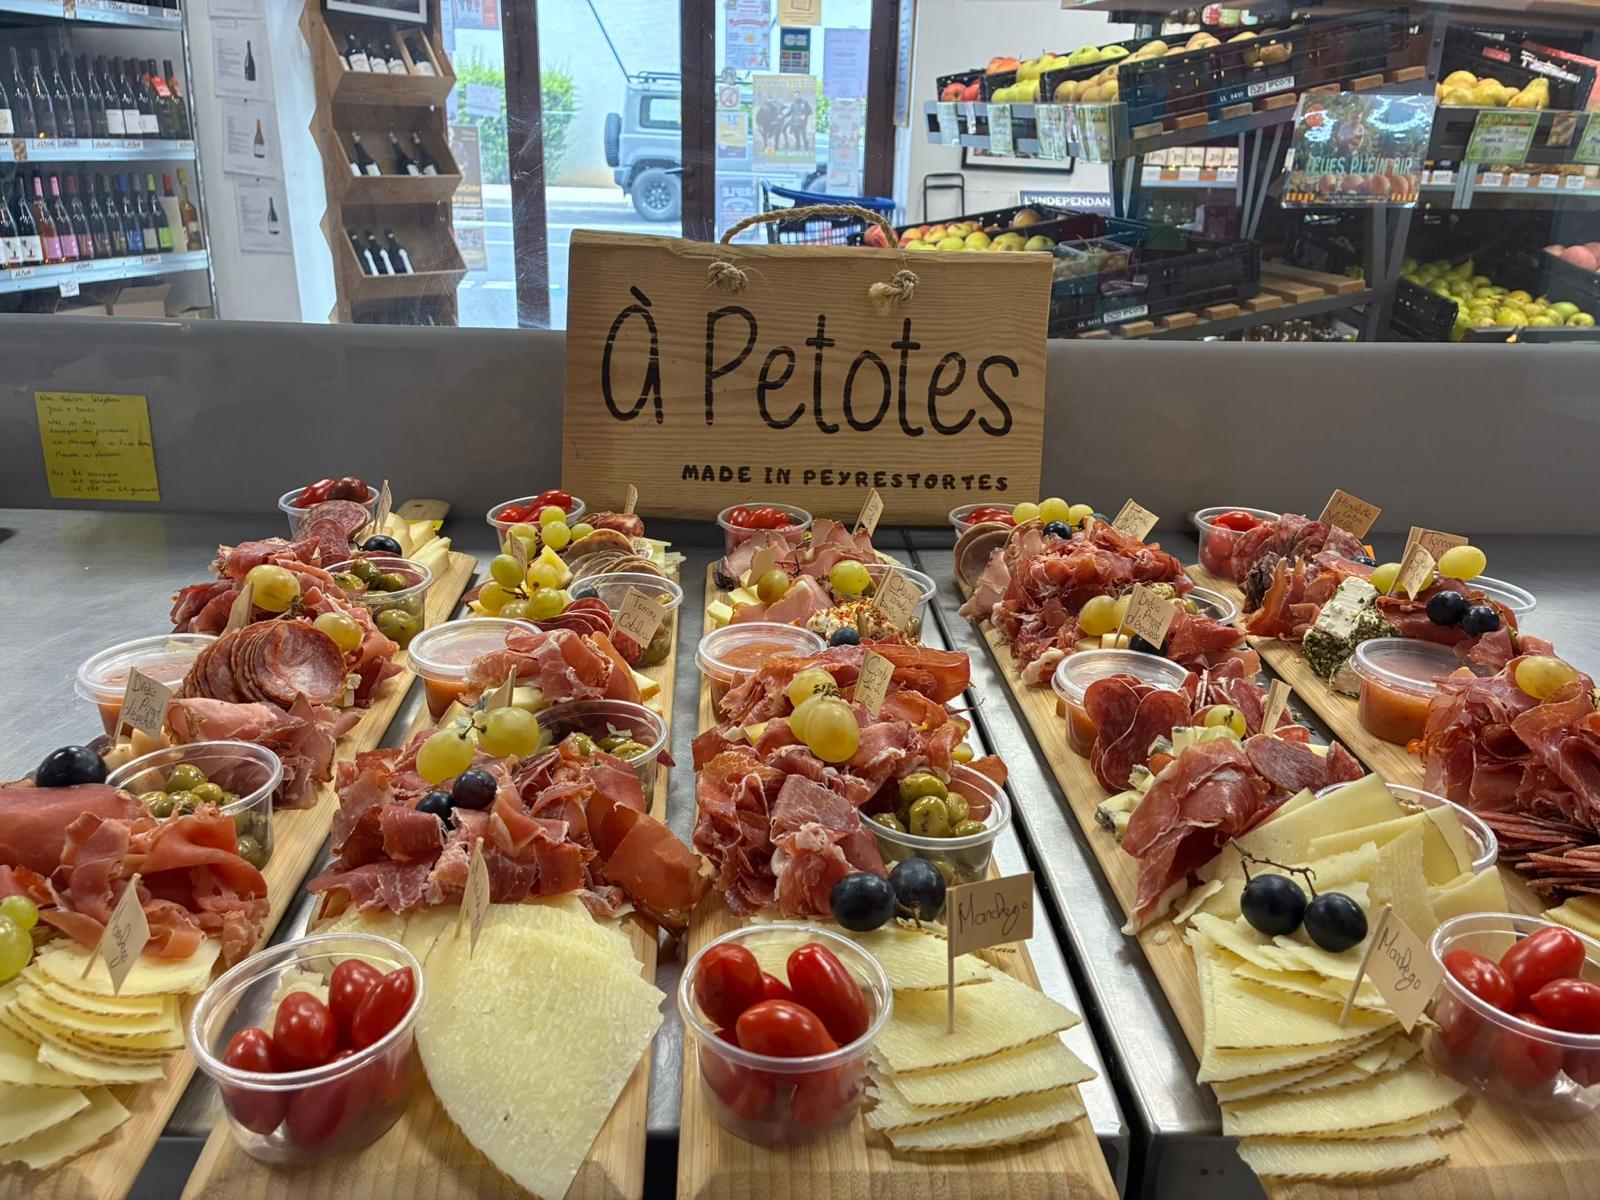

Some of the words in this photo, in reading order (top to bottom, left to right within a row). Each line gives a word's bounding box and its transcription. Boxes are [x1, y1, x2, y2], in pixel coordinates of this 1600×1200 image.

[1024, 196, 1111, 206] L'INDEPENDAN
[602, 286, 663, 425] À
[706, 305, 1019, 437] Petotes
[681, 465, 752, 483] MADE
[764, 466, 791, 484] IN
[803, 469, 1008, 491] PEYRESTORTES
